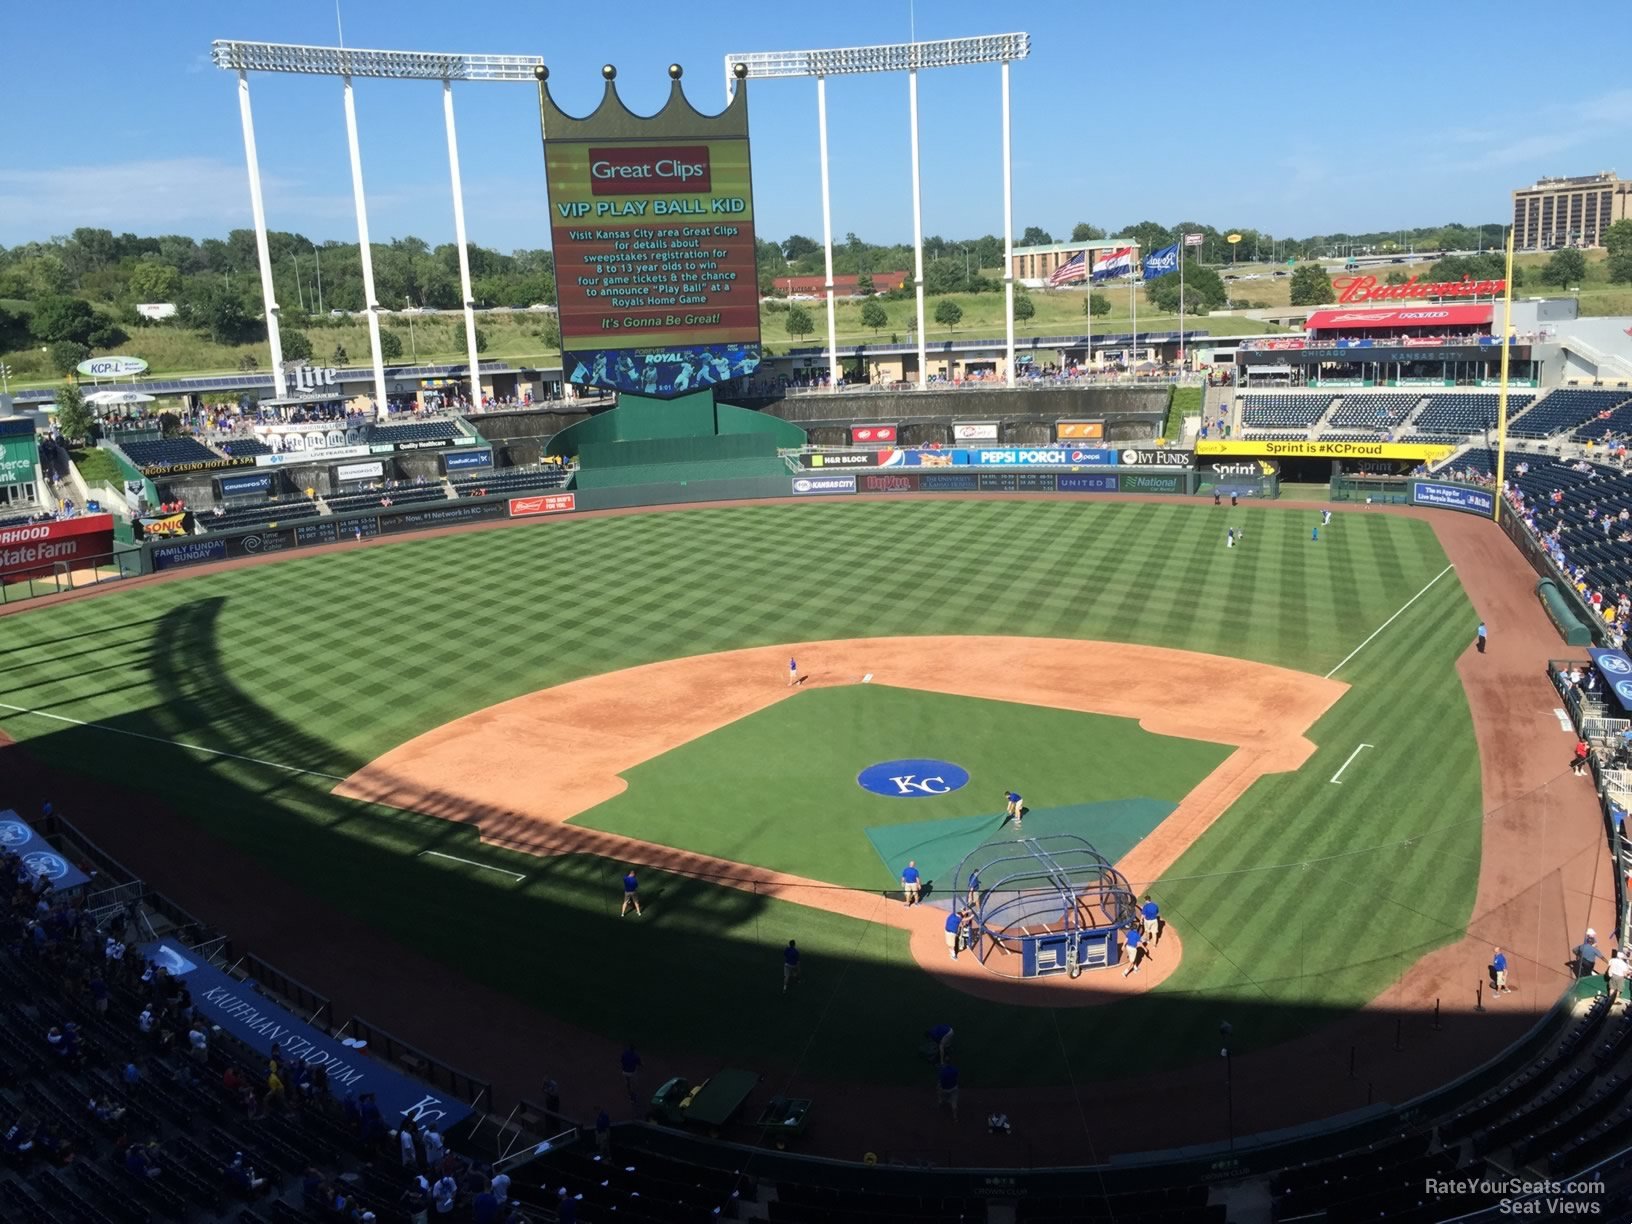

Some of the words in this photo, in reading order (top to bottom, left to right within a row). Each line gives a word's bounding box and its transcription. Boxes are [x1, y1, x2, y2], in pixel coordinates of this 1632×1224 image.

[592, 161, 652, 179] Great
[655, 159, 703, 181] Clips
[558, 202, 591, 217] VIP
[597, 201, 648, 216] PLAY
[654, 200, 706, 214] BALL
[712, 198, 745, 212] KID
[570, 231, 592, 240] Visit
[596, 230, 630, 240] Kansas
[634, 229, 654, 240] City
[657, 230, 680, 238] area
[682, 227, 710, 236] Great
[714, 226, 738, 236] Clips
[615, 242, 630, 250] for
[634, 240, 668, 250] details
[670, 239, 700, 248] about
[584, 252, 648, 264] sweepstakes
[650, 250, 710, 261] registration
[712, 249, 728, 258] for
[596, 264, 602, 273] 8
[606, 264, 616, 272] to
[620, 264, 633, 272] 13
[636, 264, 658, 274] year
[662, 262, 682, 271] olds
[686, 262, 696, 270] to
[700, 261, 716, 269] win
[578, 276, 600, 286] four
[602, 277, 630, 286] game
[632, 274, 667, 284] tickets
[670, 274, 678, 282] &
[682, 272, 698, 281] the
[702, 272, 736, 280] chance
[586, 288, 597, 297] to
[600, 286, 649, 296] announce
[710, 284, 721, 292] at
[1332, 273, 1507, 304] Budweiser
[612, 298, 644, 308] Royals
[648, 296, 676, 306] Home
[679, 295, 707, 304] Game
[602, 318, 620, 328] It's
[624, 316, 662, 327] Gonna
[666, 315, 681, 326] Be
[684, 313, 720, 325] Great!
[1398, 312, 1449, 320] PATIO
[644, 353, 684, 364] ROYAL
[1301, 350, 1346, 358] CHICAGO
[294, 366, 337, 393] Lite
[1266, 442, 1305, 454] Sprint
[1306, 443, 1316, 453] is
[1318, 443, 1382, 455] #KCProud
[842, 455, 868, 463] BLOCK
[980, 450, 1016, 464] PEPSI
[1018, 450, 1066, 464] PORCH
[1082, 454, 1100, 462] pepsi
[173, 463, 203, 472] CASINO
[205, 460, 230, 468] HOTEL
[1212, 463, 1256, 480] Sprint
[1358, 461, 1392, 472] Sprint
[224, 482, 260, 490] GRUNDFOS
[1137, 478, 1178, 488] National
[1446, 497, 1466, 505] Baseball
[432, 510, 462, 518] Network
[470, 506, 482, 514] KC
[145, 520, 182, 532] SONIC
[0, 526, 50, 543] RHOOD
[38, 540, 76, 560] Farm
[154, 546, 187, 558] FAMILY
[189, 540, 225, 552] FUNDAY
[174, 550, 211, 562] SUNDAY
[888, 774, 950, 794] KC
[202, 986, 289, 1042] KAUFFMAN
[279, 1035, 364, 1086] STADIUM
[399, 1094, 447, 1131] KC
